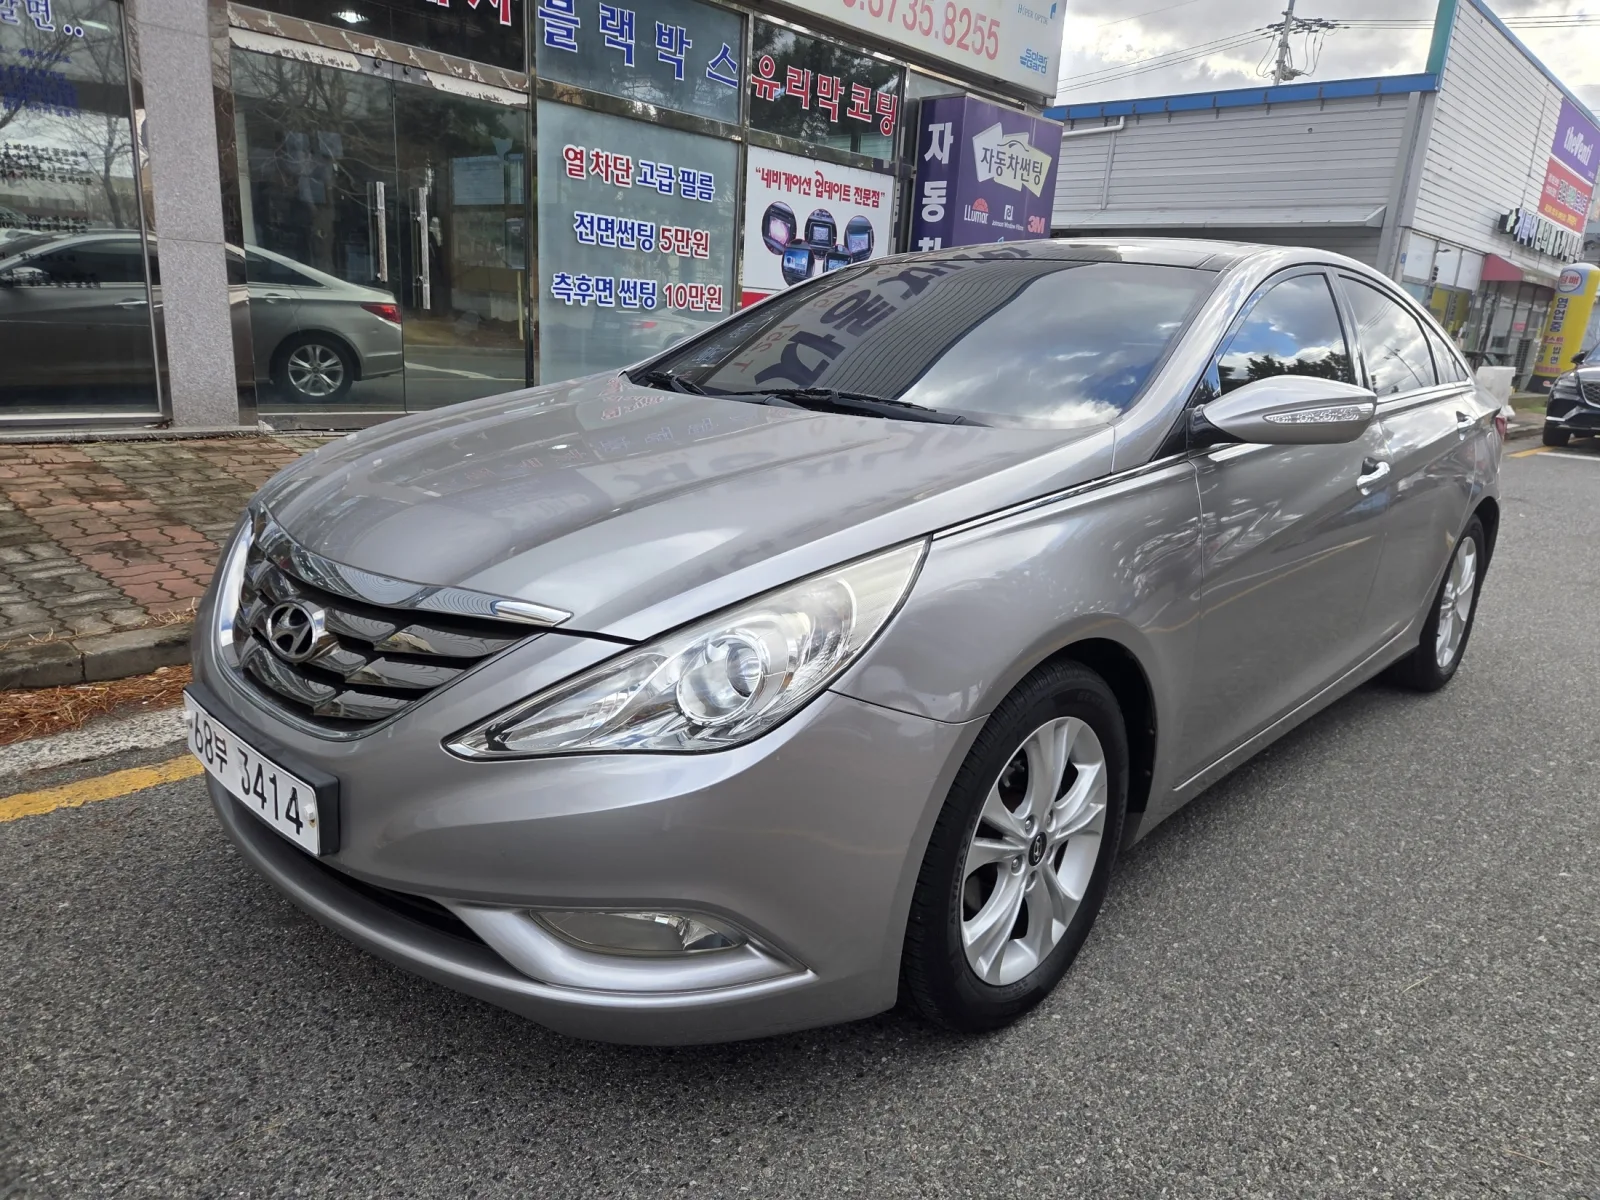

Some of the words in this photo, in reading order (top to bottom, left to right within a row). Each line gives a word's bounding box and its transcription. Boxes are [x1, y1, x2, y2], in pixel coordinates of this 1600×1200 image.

[537, 0, 739, 89] 블랙박스
[1025, 48, 1048, 65] Solar
[1026, 58, 1048, 74] Gard
[750, 55, 898, 136] 유리막코팅
[636, 159, 675, 195] 고급
[678, 167, 715, 203] 필름
[980, 146, 1044, 186] 자동차썬팅
[573, 211, 655, 252] 전면썬팅
[659, 225, 710, 259] 5만원
[1027, 215, 1046, 234] 3M
[551, 272, 616, 306] 측후면
[618, 278, 658, 309] 썬팅
[663, 283, 724, 313] 10만원
[194, 711, 228, 774] 68부
[236, 746, 304, 836] 3414
